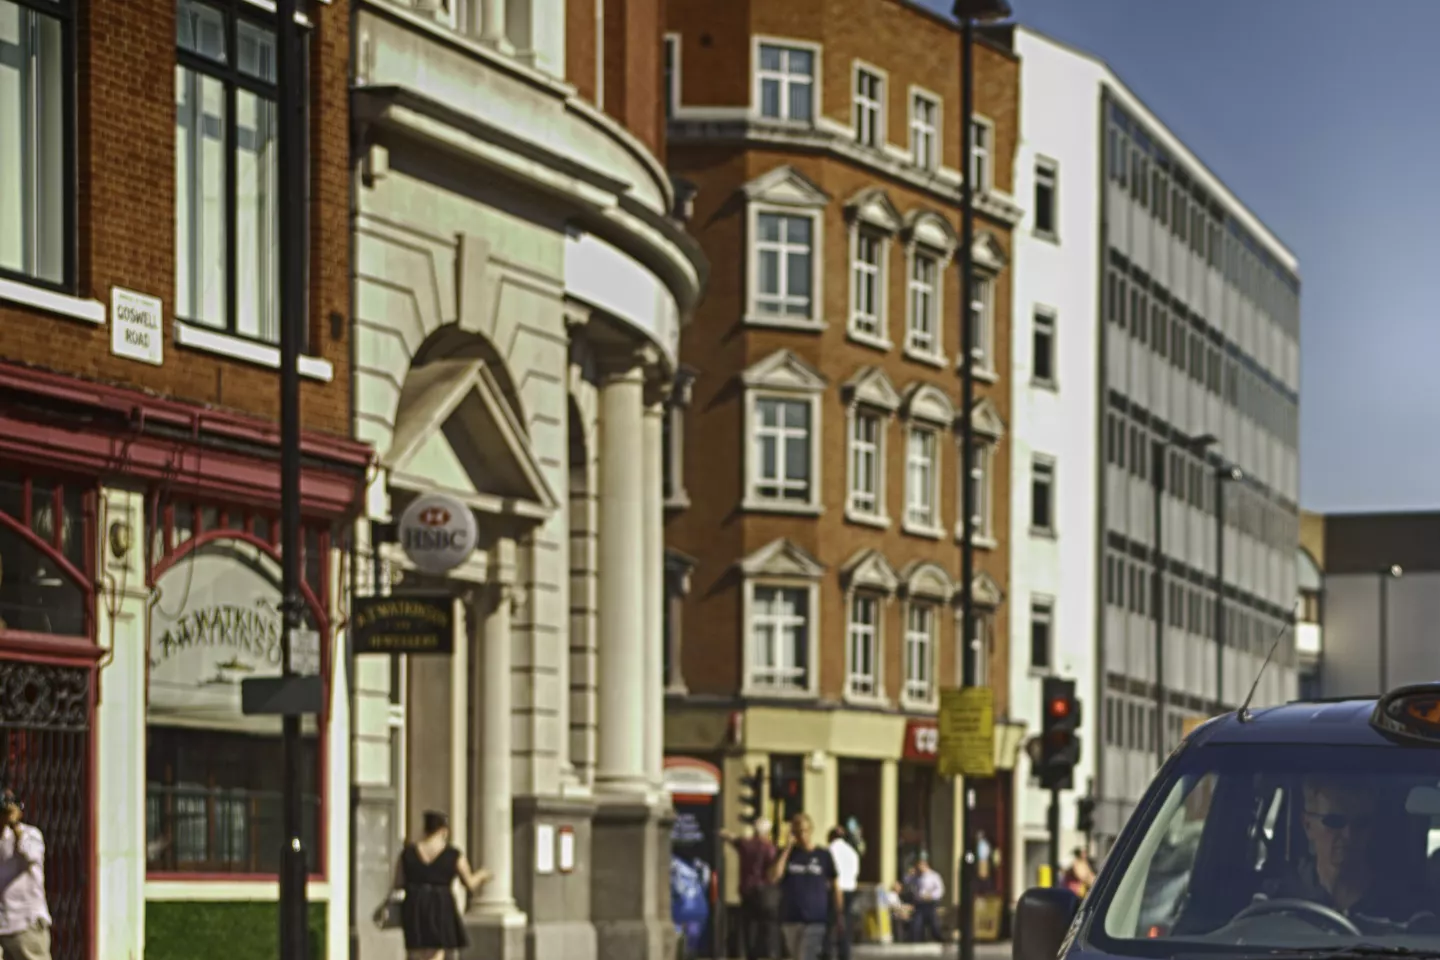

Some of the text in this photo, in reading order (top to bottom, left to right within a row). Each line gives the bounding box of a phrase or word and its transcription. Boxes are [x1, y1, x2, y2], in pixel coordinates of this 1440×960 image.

[117, 304, 157, 329] GOSWELL
[125, 327, 150, 349] ROAD
[406, 527, 467, 550] HSBC
